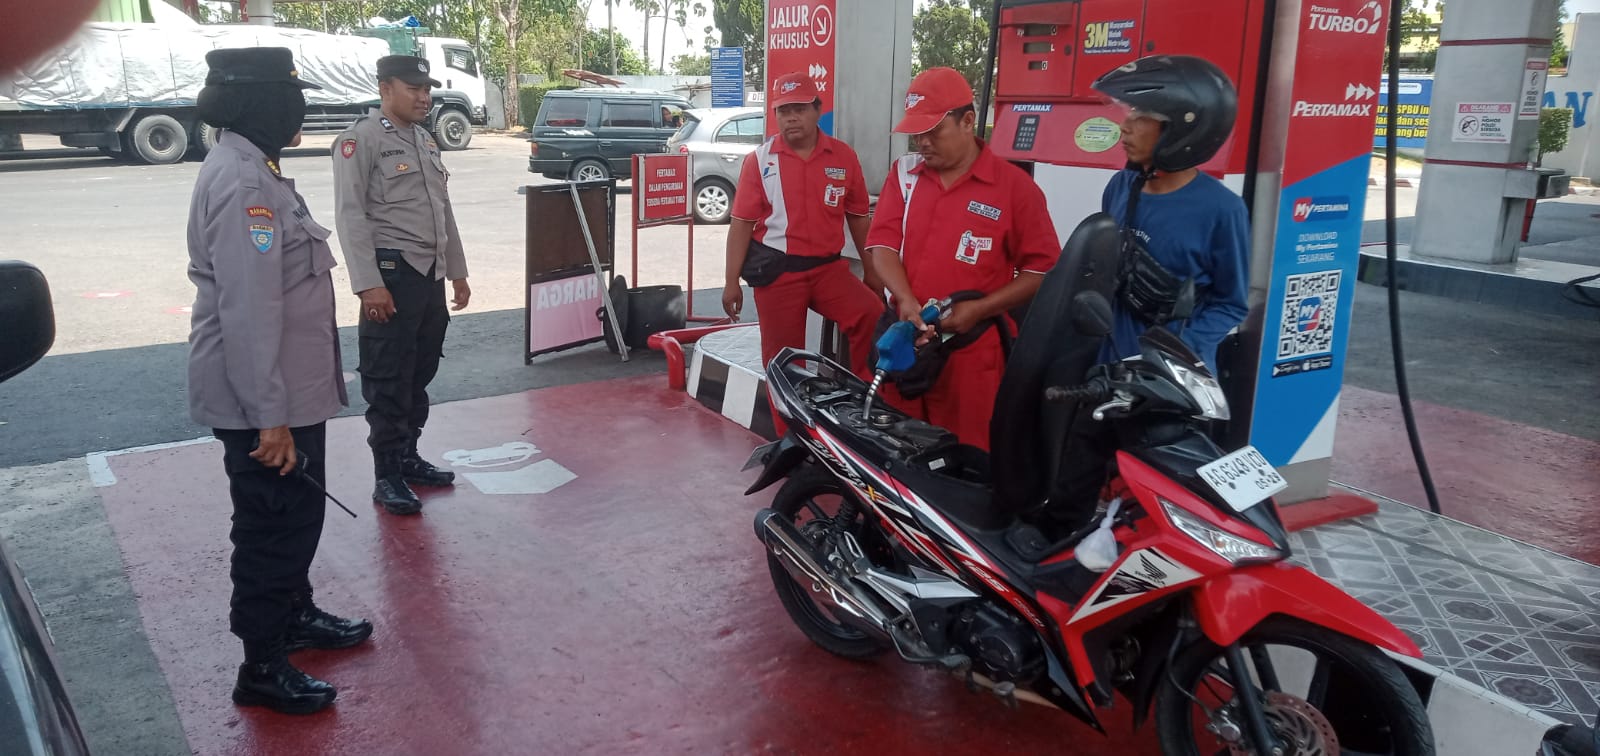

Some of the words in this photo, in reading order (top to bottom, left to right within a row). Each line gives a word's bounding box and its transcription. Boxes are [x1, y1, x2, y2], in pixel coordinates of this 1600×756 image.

[771, 5, 809, 29] JALUR
[1310, 5, 1339, 14] PERTAMAX
[1309, 14, 1369, 33] TURBO
[770, 31, 810, 50] KHUSUS
[1084, 22, 1109, 49] 3M
[1013, 104, 1051, 112] PERTAMAX
[1292, 101, 1372, 117] PERTAMAX
[1397, 105, 1419, 114] SPBU
[1294, 203, 1315, 219] My
[1313, 204, 1349, 212] PERTAMINA
[1298, 232, 1338, 242] DOWNLOAD
[1300, 305, 1321, 319] My
[1205, 468, 1227, 488] AG
